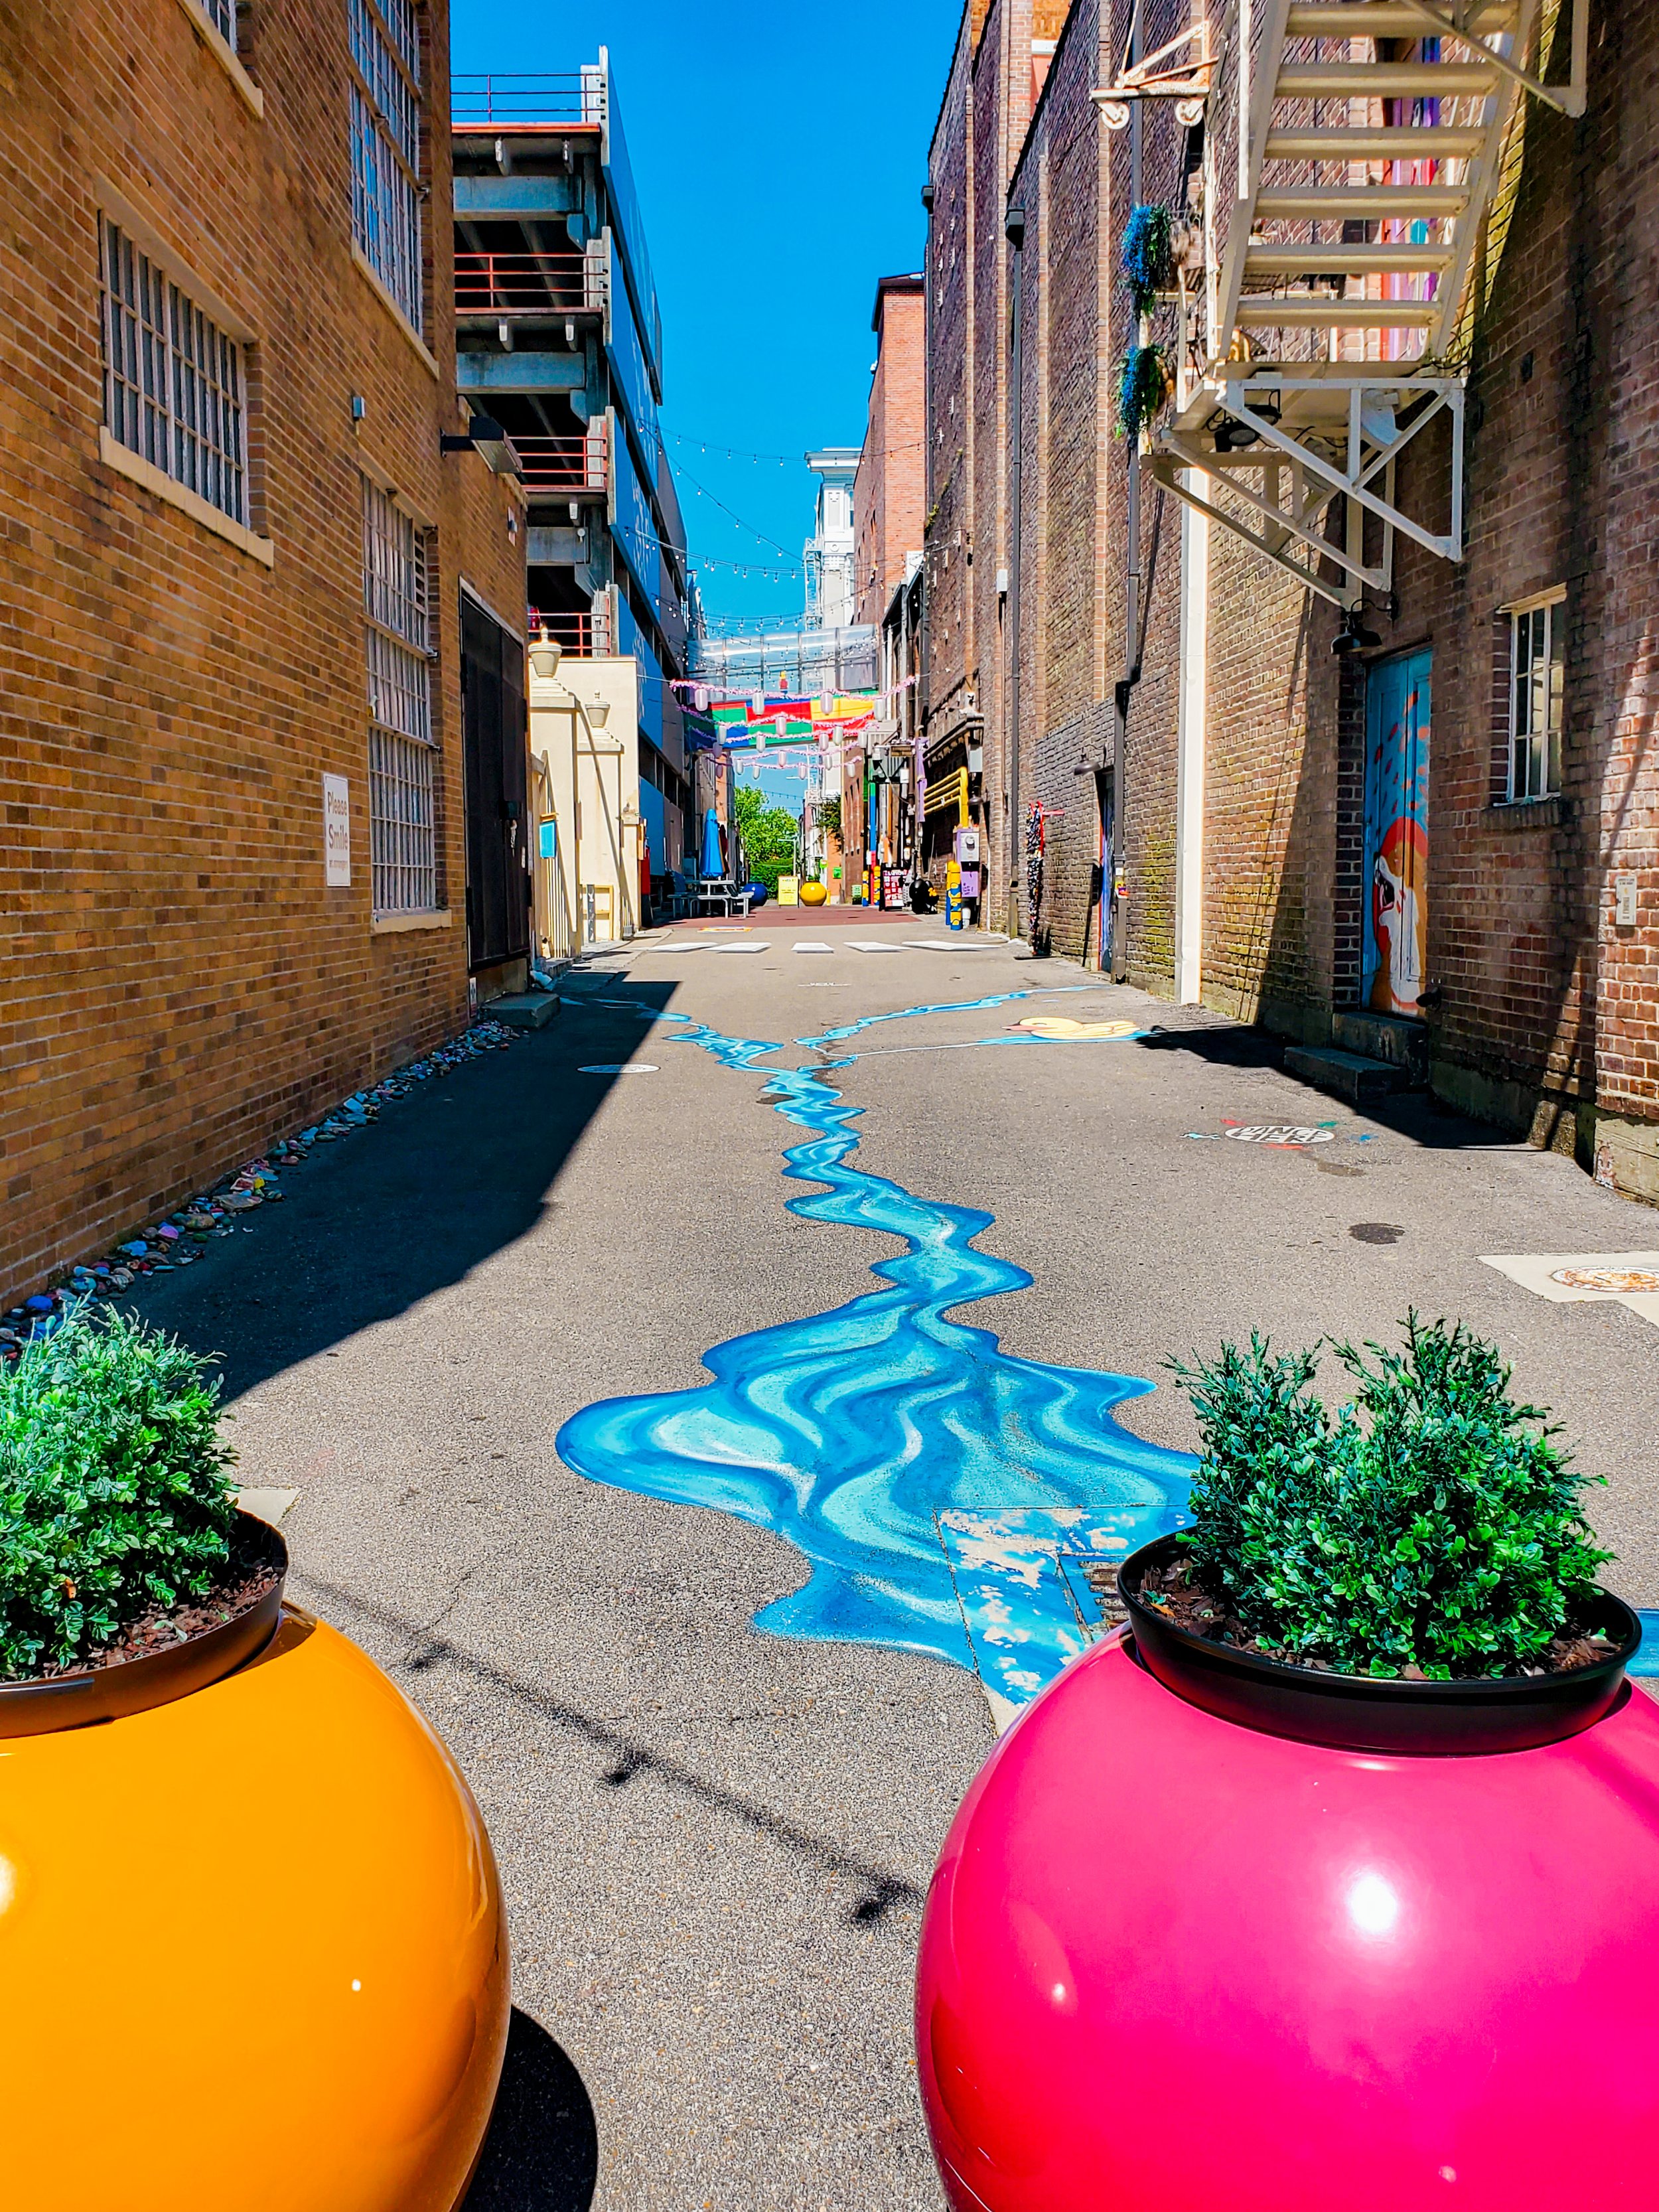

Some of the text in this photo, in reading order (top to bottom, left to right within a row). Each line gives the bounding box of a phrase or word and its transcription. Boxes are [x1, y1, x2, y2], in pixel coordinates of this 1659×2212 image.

[327, 791, 348, 816] Please
[328, 824, 348, 850] Smile
[1238, 1127, 1327, 1138] DANCE
